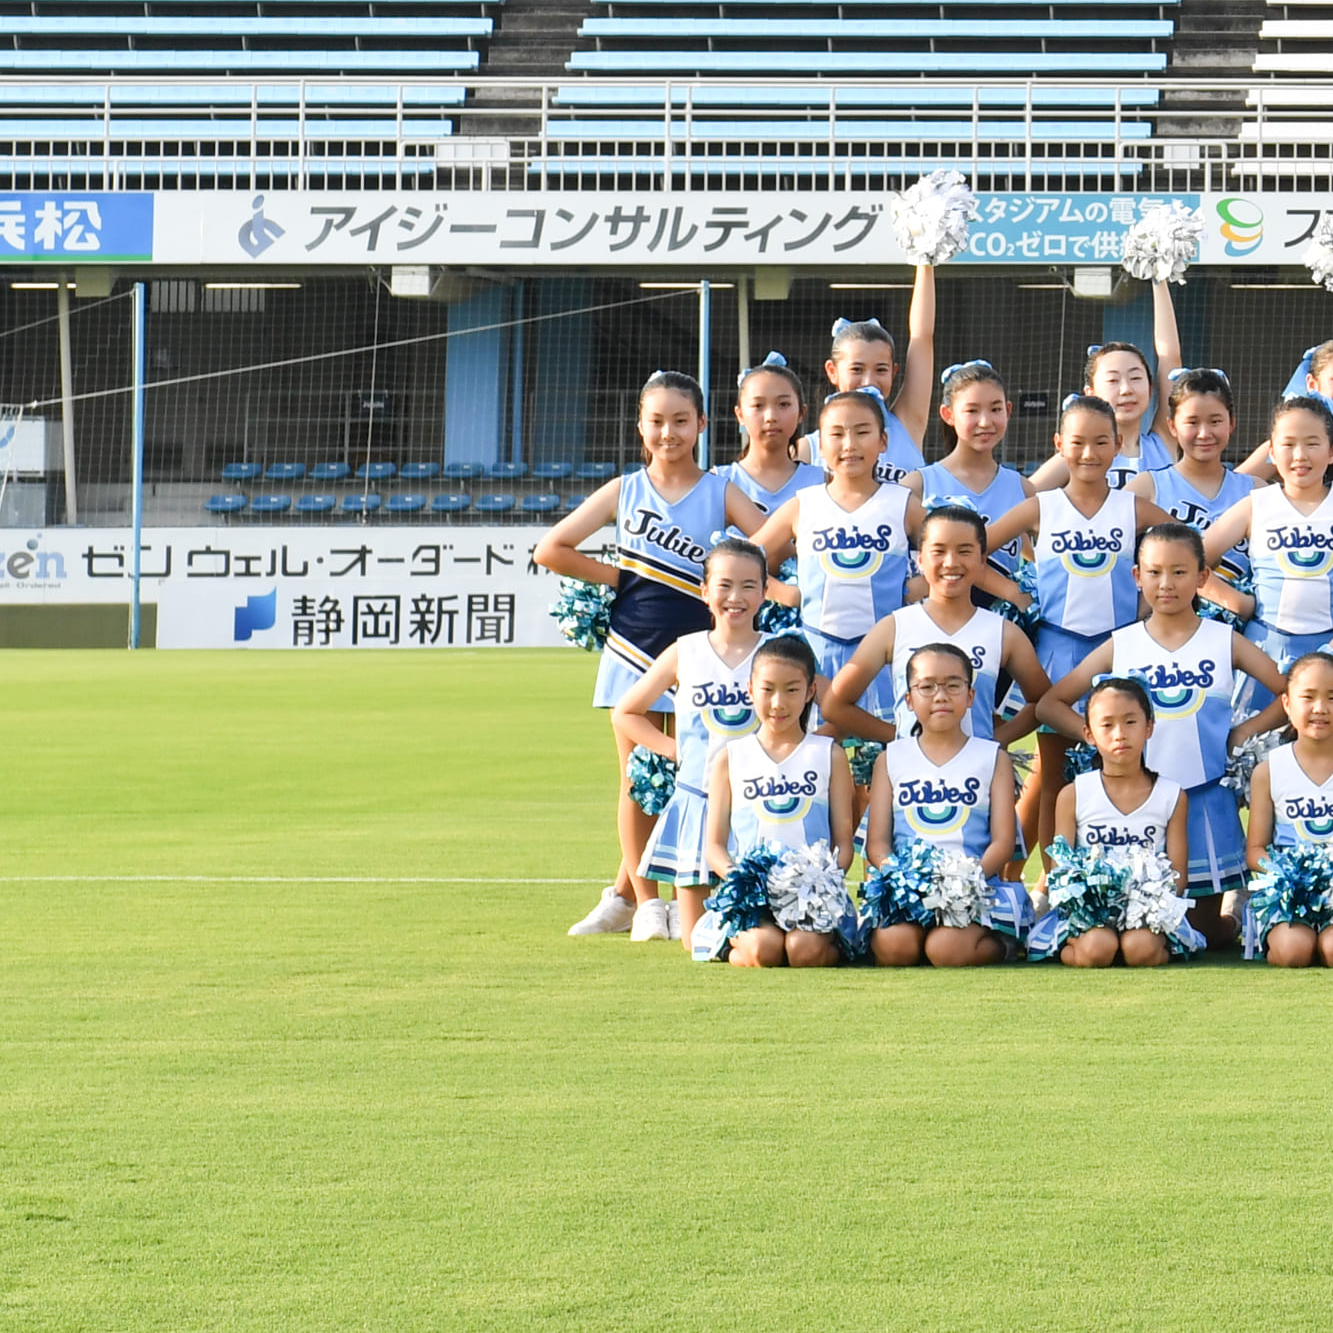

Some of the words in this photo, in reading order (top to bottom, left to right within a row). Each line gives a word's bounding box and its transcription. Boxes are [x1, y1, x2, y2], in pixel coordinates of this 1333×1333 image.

[304, 203, 883, 253] アイジーコンサルティング
[624, 508, 706, 563] Jubie
[292, 595, 515, 647] 静岡新聞
